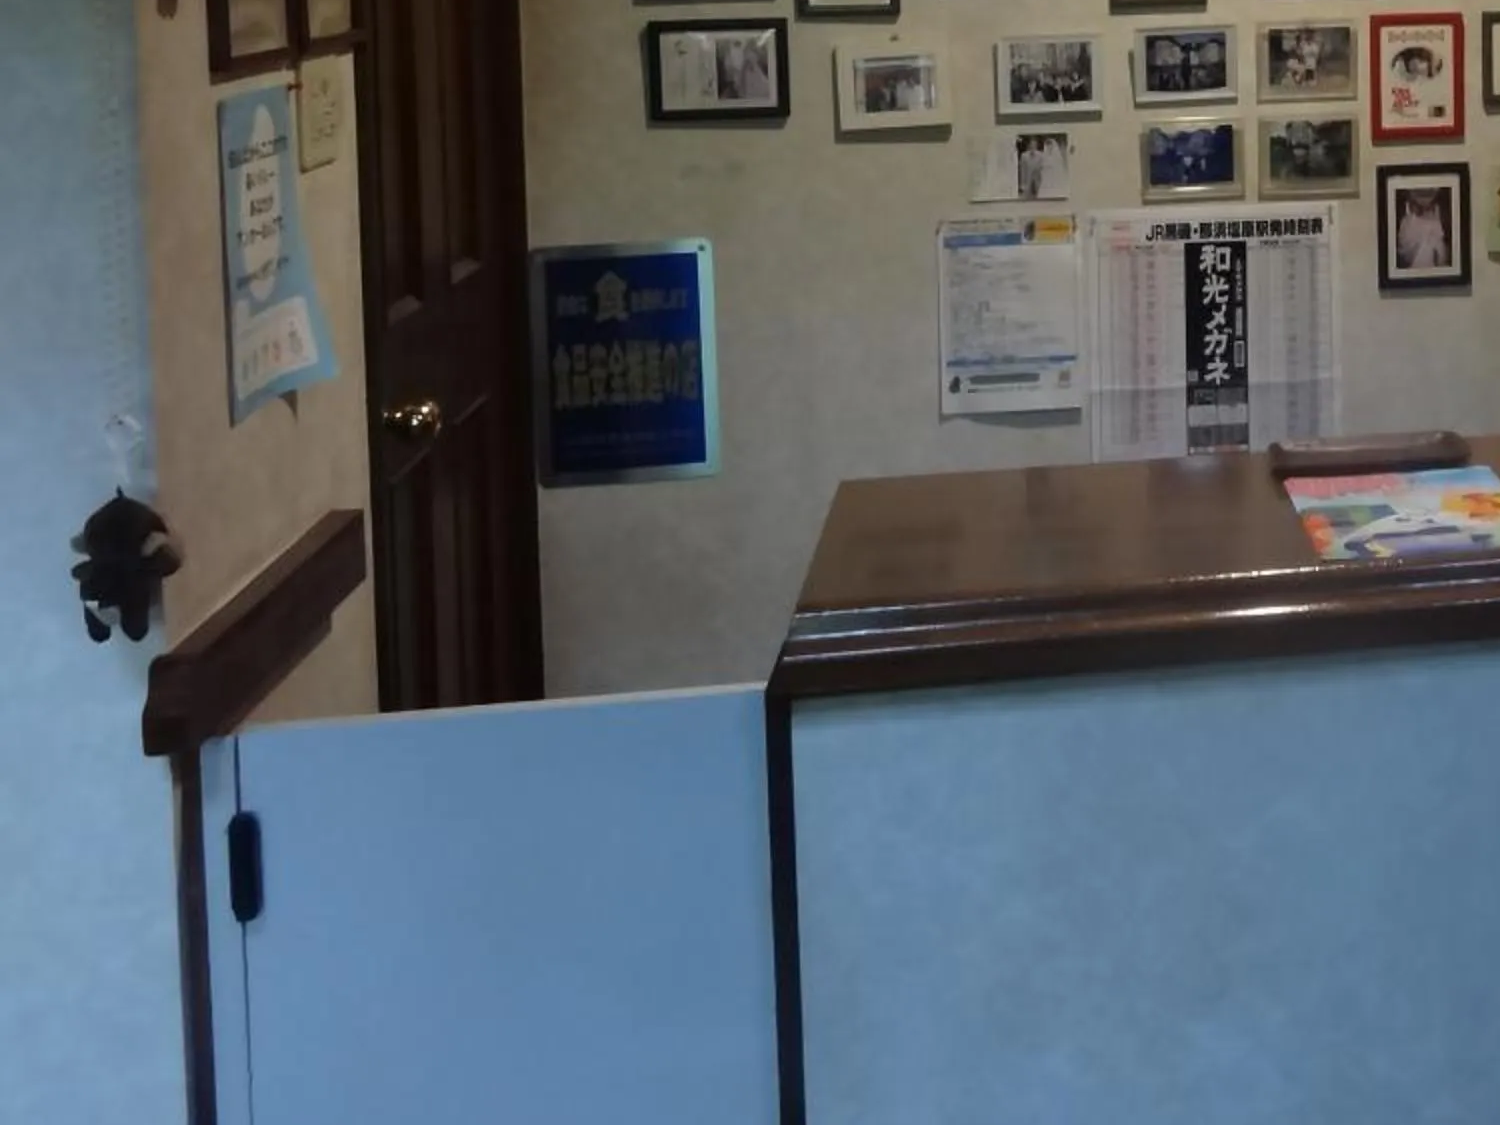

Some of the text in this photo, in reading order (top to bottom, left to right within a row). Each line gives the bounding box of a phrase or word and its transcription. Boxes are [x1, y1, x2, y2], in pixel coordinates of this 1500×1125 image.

[1200, 245, 1233, 386] 和光メガネ
